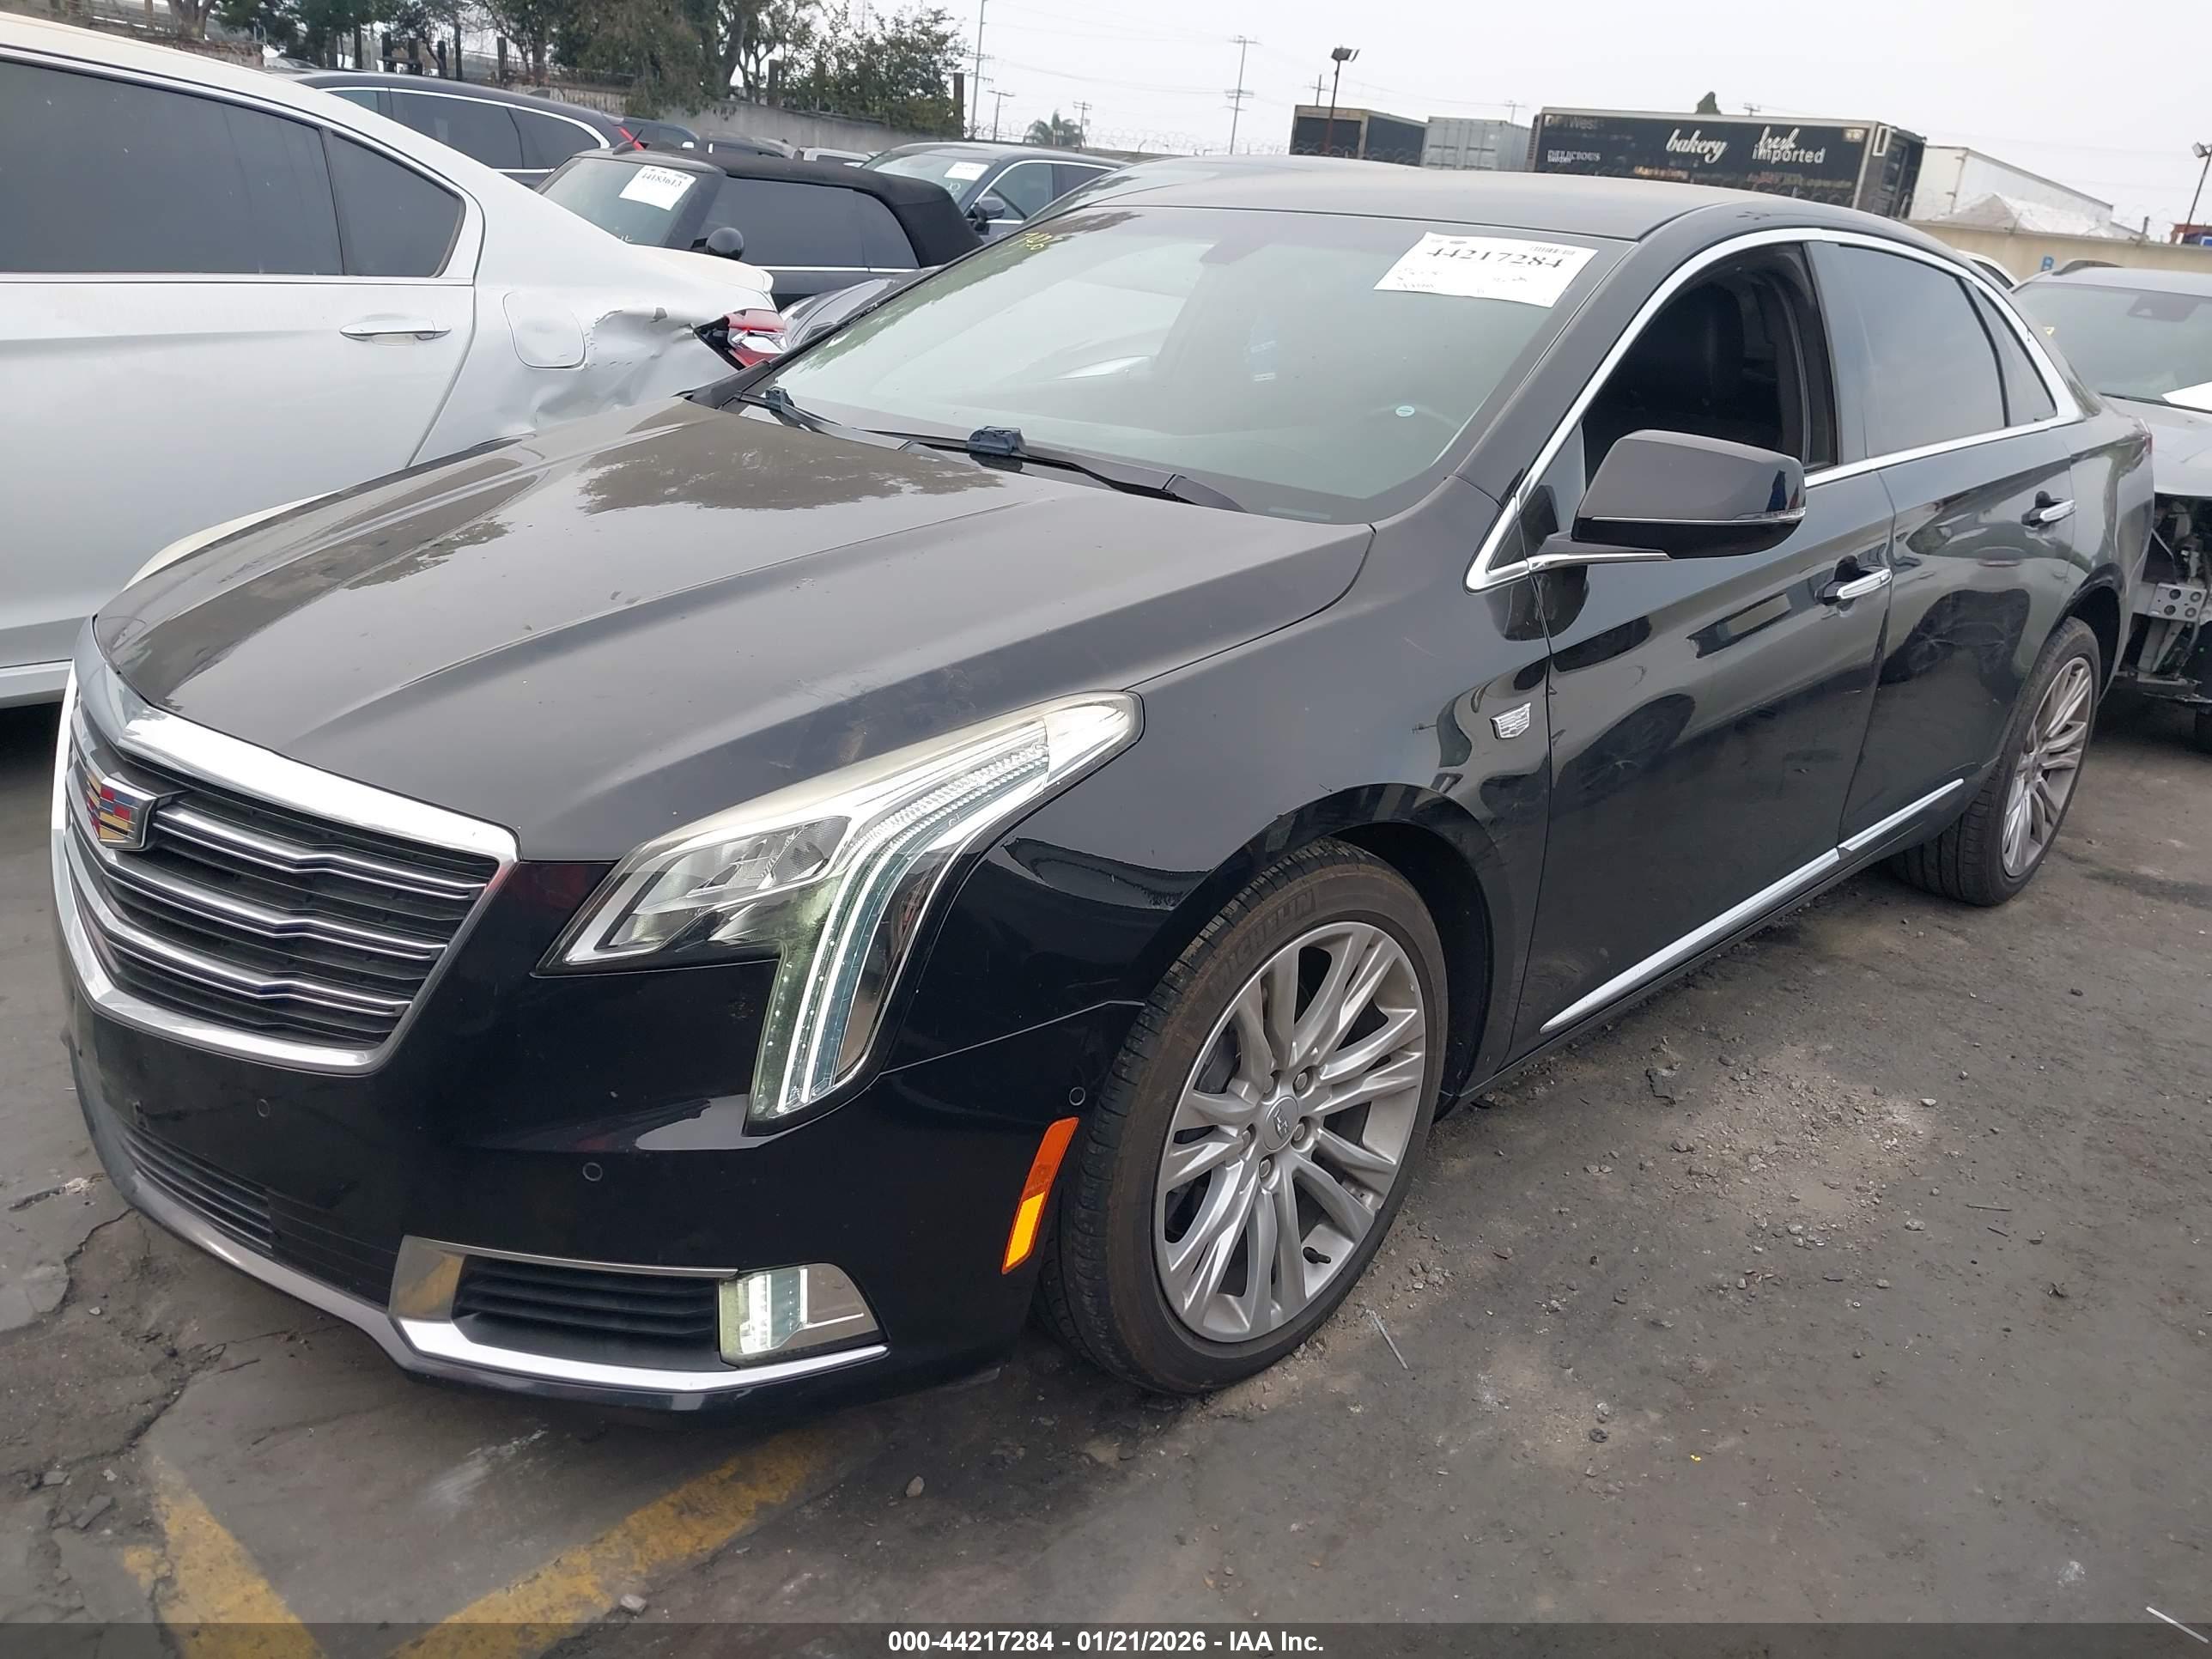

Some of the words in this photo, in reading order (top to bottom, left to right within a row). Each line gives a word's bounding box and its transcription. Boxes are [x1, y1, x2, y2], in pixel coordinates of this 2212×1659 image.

[1665, 128, 1729, 164] bakery
[1752, 144, 1826, 164] imported
[1426, 246, 1565, 269] 44217284
